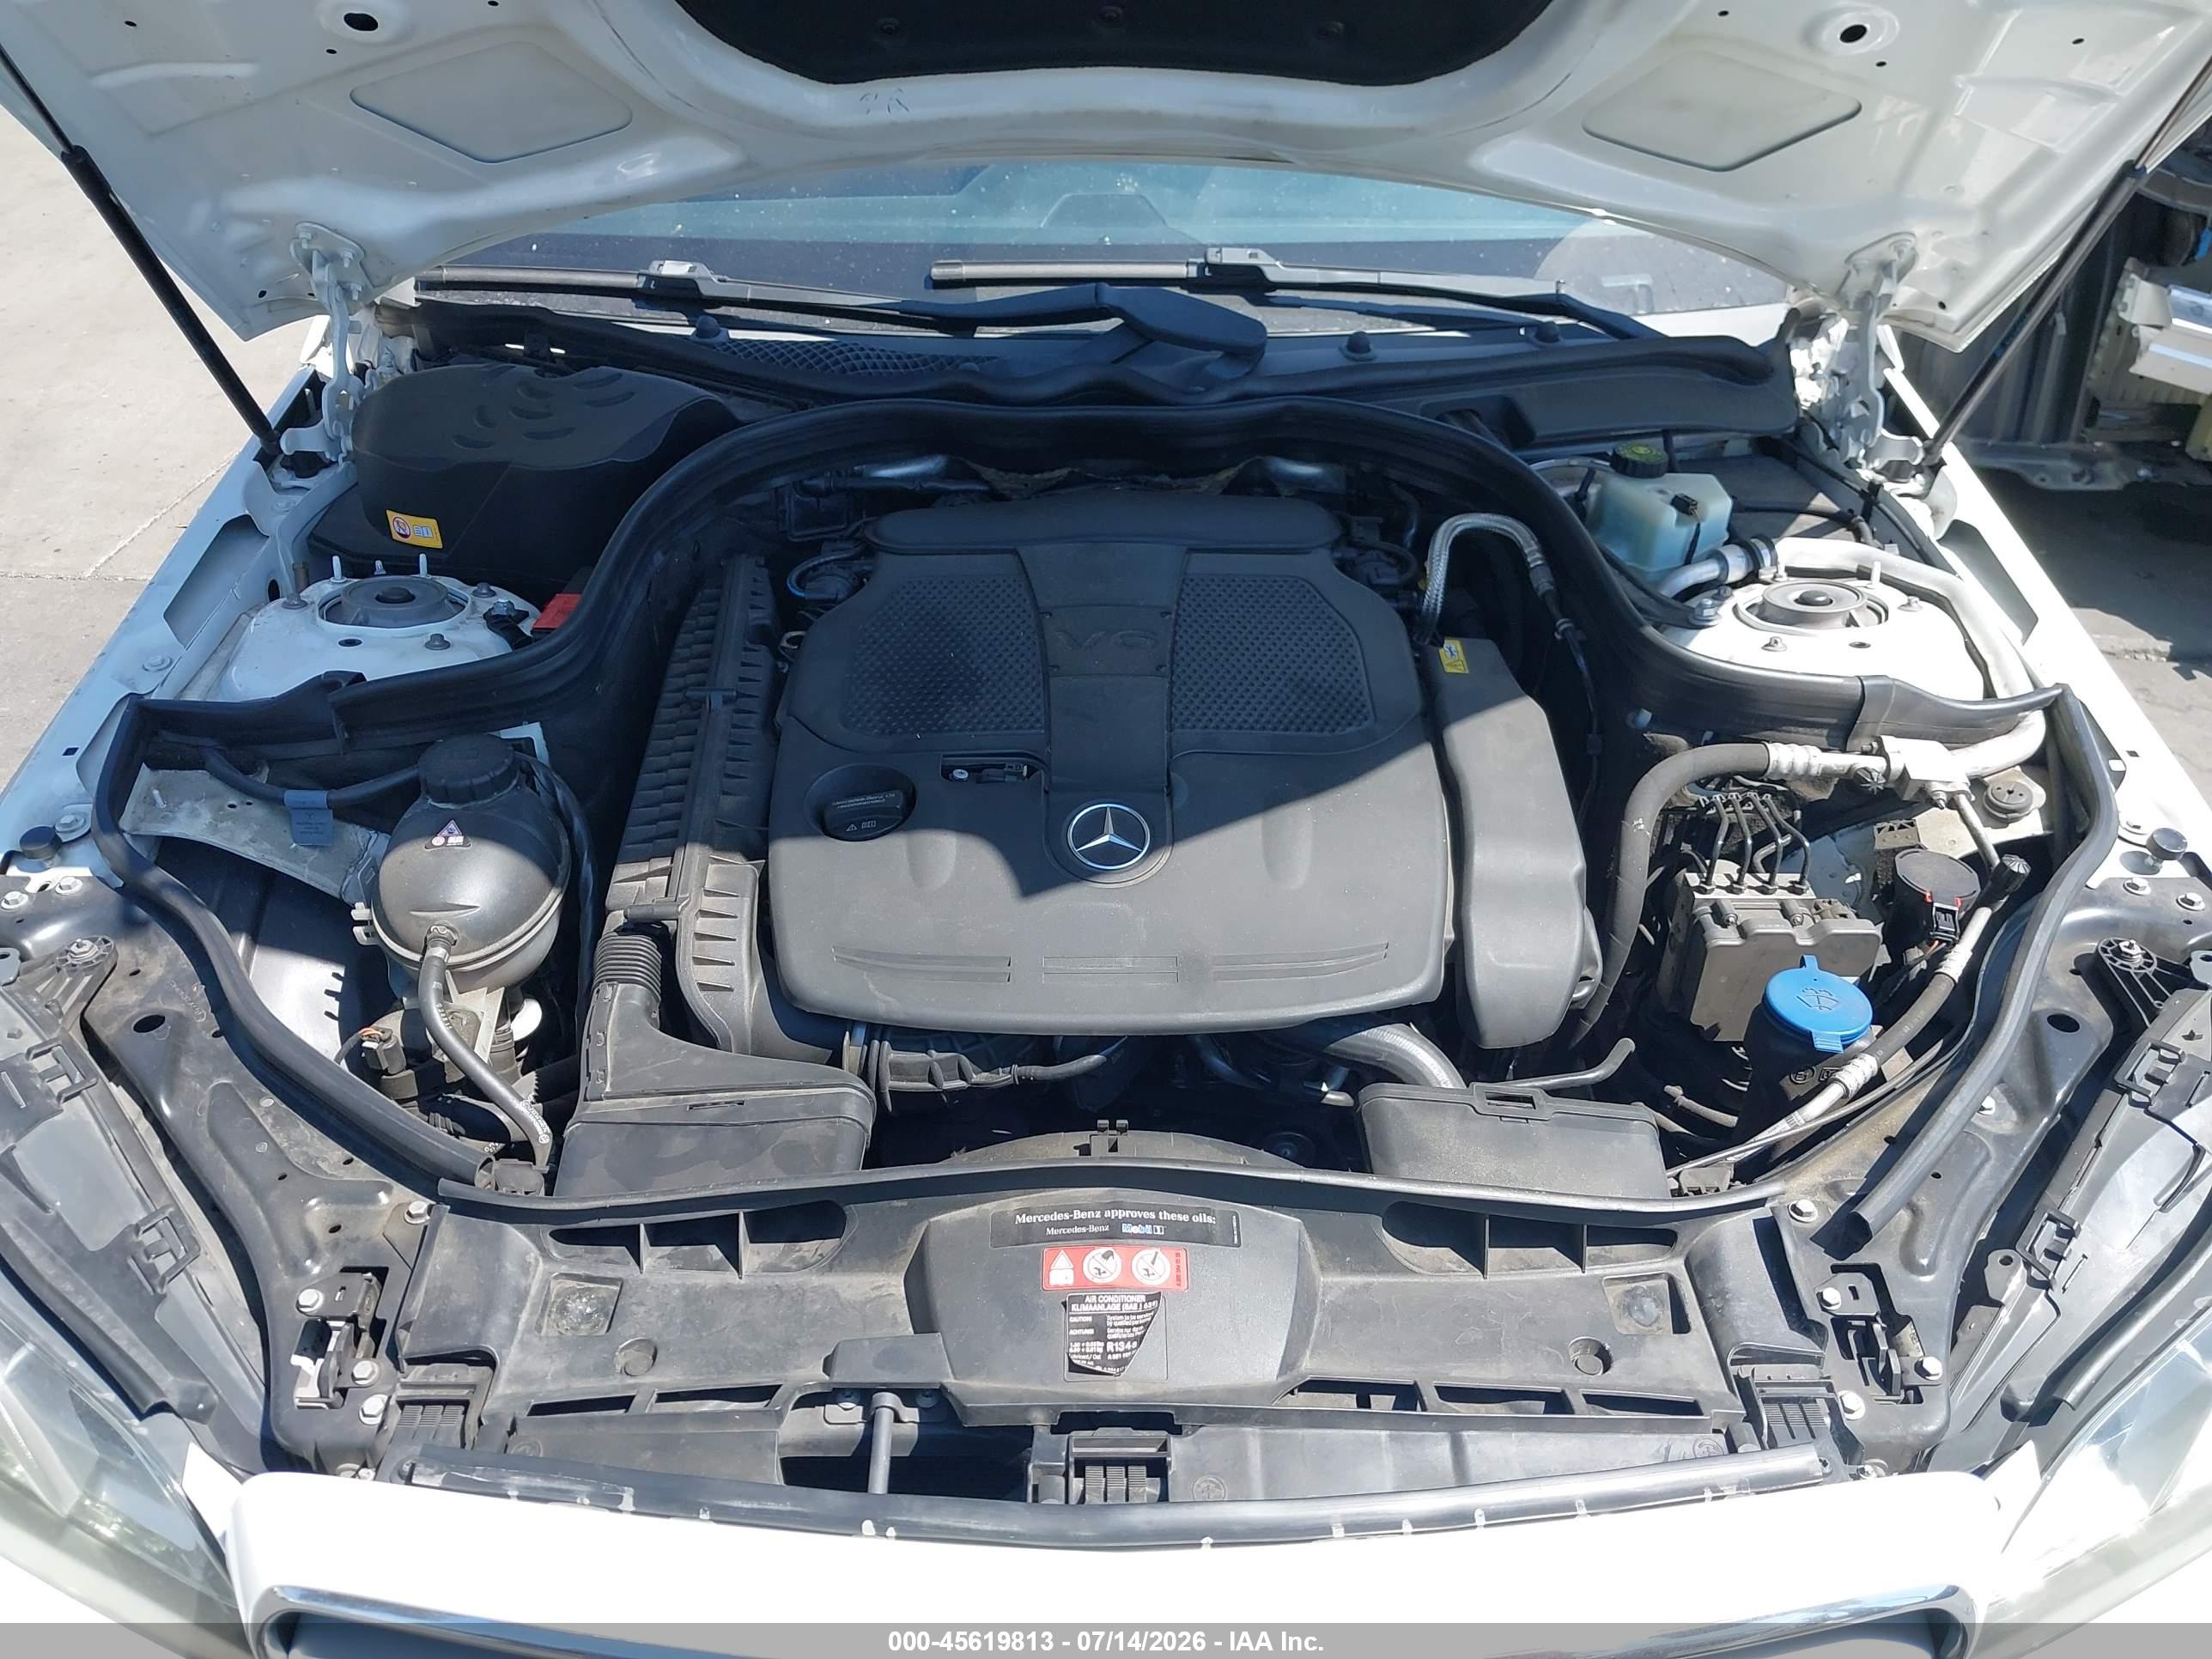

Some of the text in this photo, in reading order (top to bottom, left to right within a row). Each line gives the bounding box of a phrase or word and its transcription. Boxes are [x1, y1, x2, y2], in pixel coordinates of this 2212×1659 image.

[1015, 1209, 1217, 1224] Mercedes-Benz approves these oils:
[1046, 1224, 1110, 1235] Mercedes-Benz
[1121, 1223, 1152, 1235] Mobil
[1085, 1295, 1146, 1304] AIR CONDITIONER
